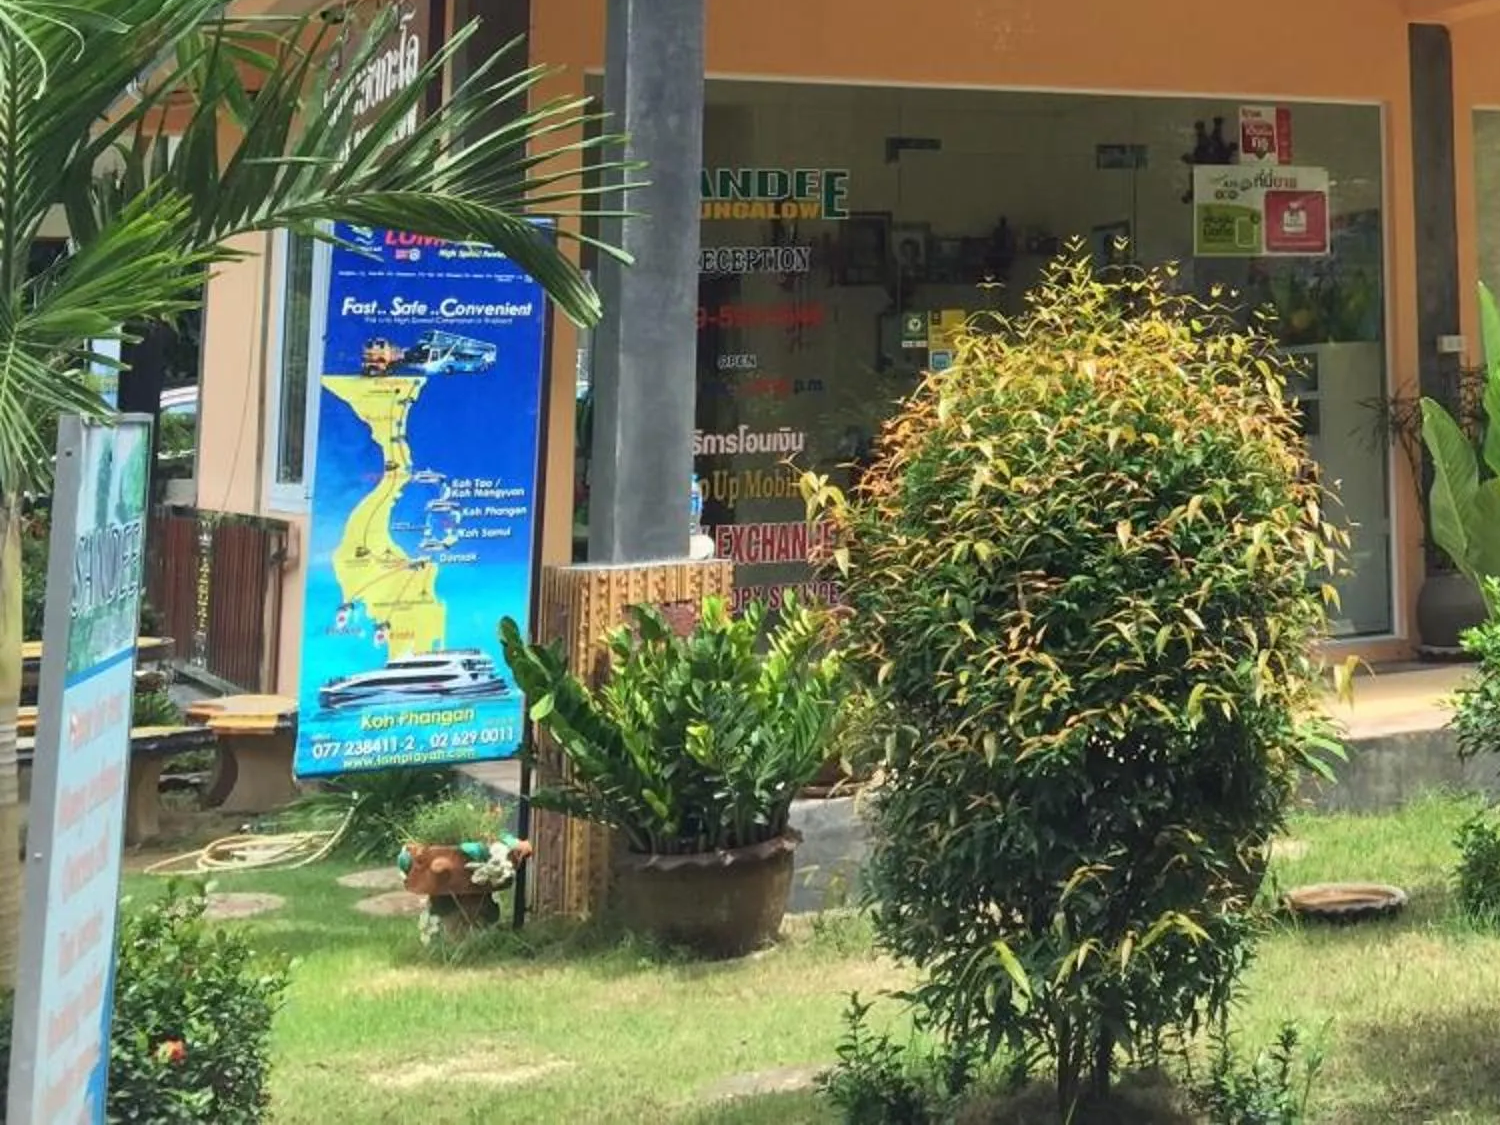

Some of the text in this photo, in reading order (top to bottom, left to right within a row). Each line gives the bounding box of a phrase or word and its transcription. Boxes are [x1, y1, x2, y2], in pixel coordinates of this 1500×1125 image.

[698, 246, 812, 274] ECEPTION
[360, 712, 395, 731] Koh
[399, 708, 475, 726] Phangan
[312, 741, 341, 760] 077
[429, 733, 450, 750] 02
[451, 730, 477, 747] 629
[480, 726, 514, 743] 0011
